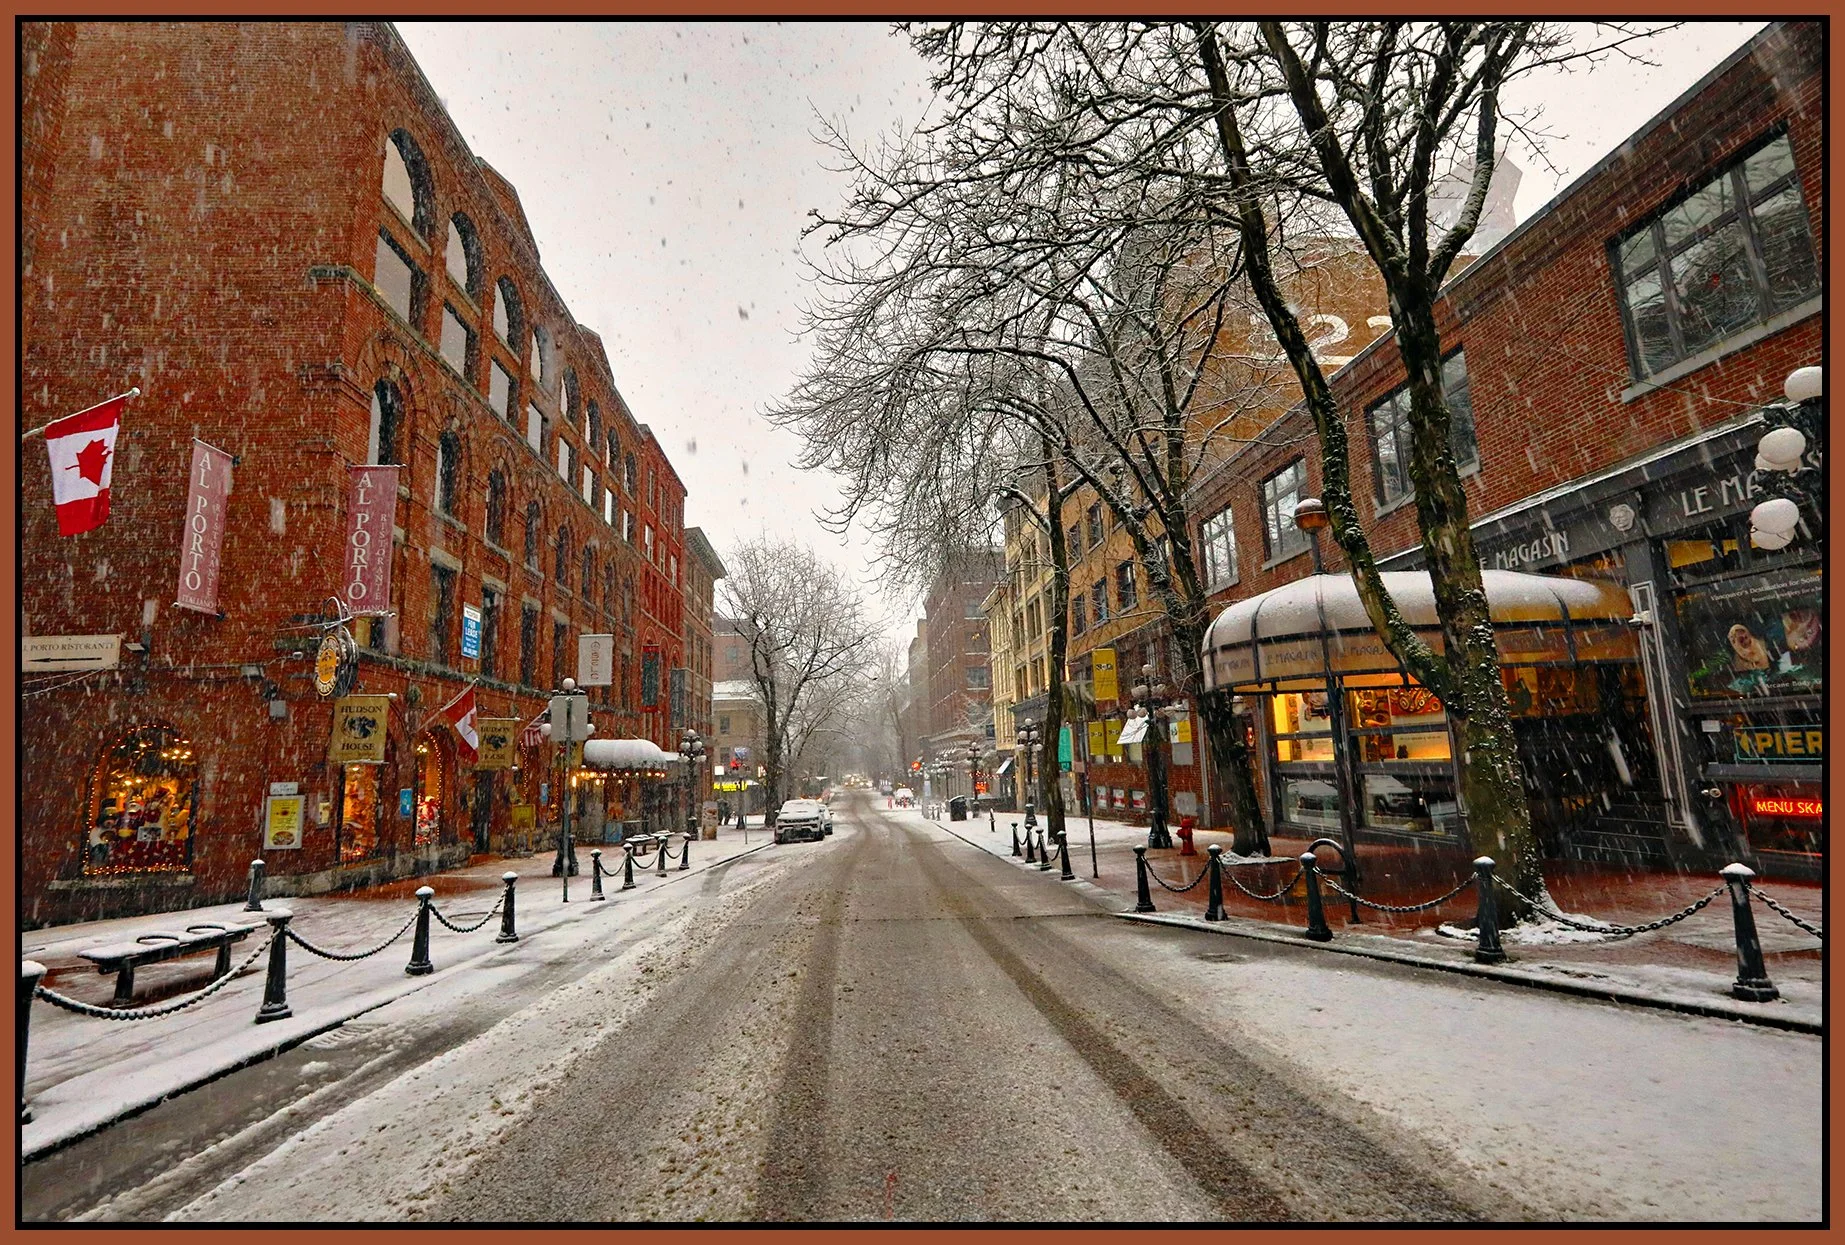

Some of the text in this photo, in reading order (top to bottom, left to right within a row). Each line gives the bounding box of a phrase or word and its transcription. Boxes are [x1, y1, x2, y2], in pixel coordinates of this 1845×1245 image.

[1681, 485, 1714, 517] LE
[185, 451, 212, 591] AL PORTO
[348, 471, 373, 600] AL PORTO
[1495, 530, 1569, 570] MAGASIN
[30, 643, 60, 651] PORTO
[61, 642, 114, 651] RISTORANTE
[340, 705, 382, 713] HUDSON
[341, 743, 376, 751] HOUSE
[1756, 801, 1793, 813] MENU
